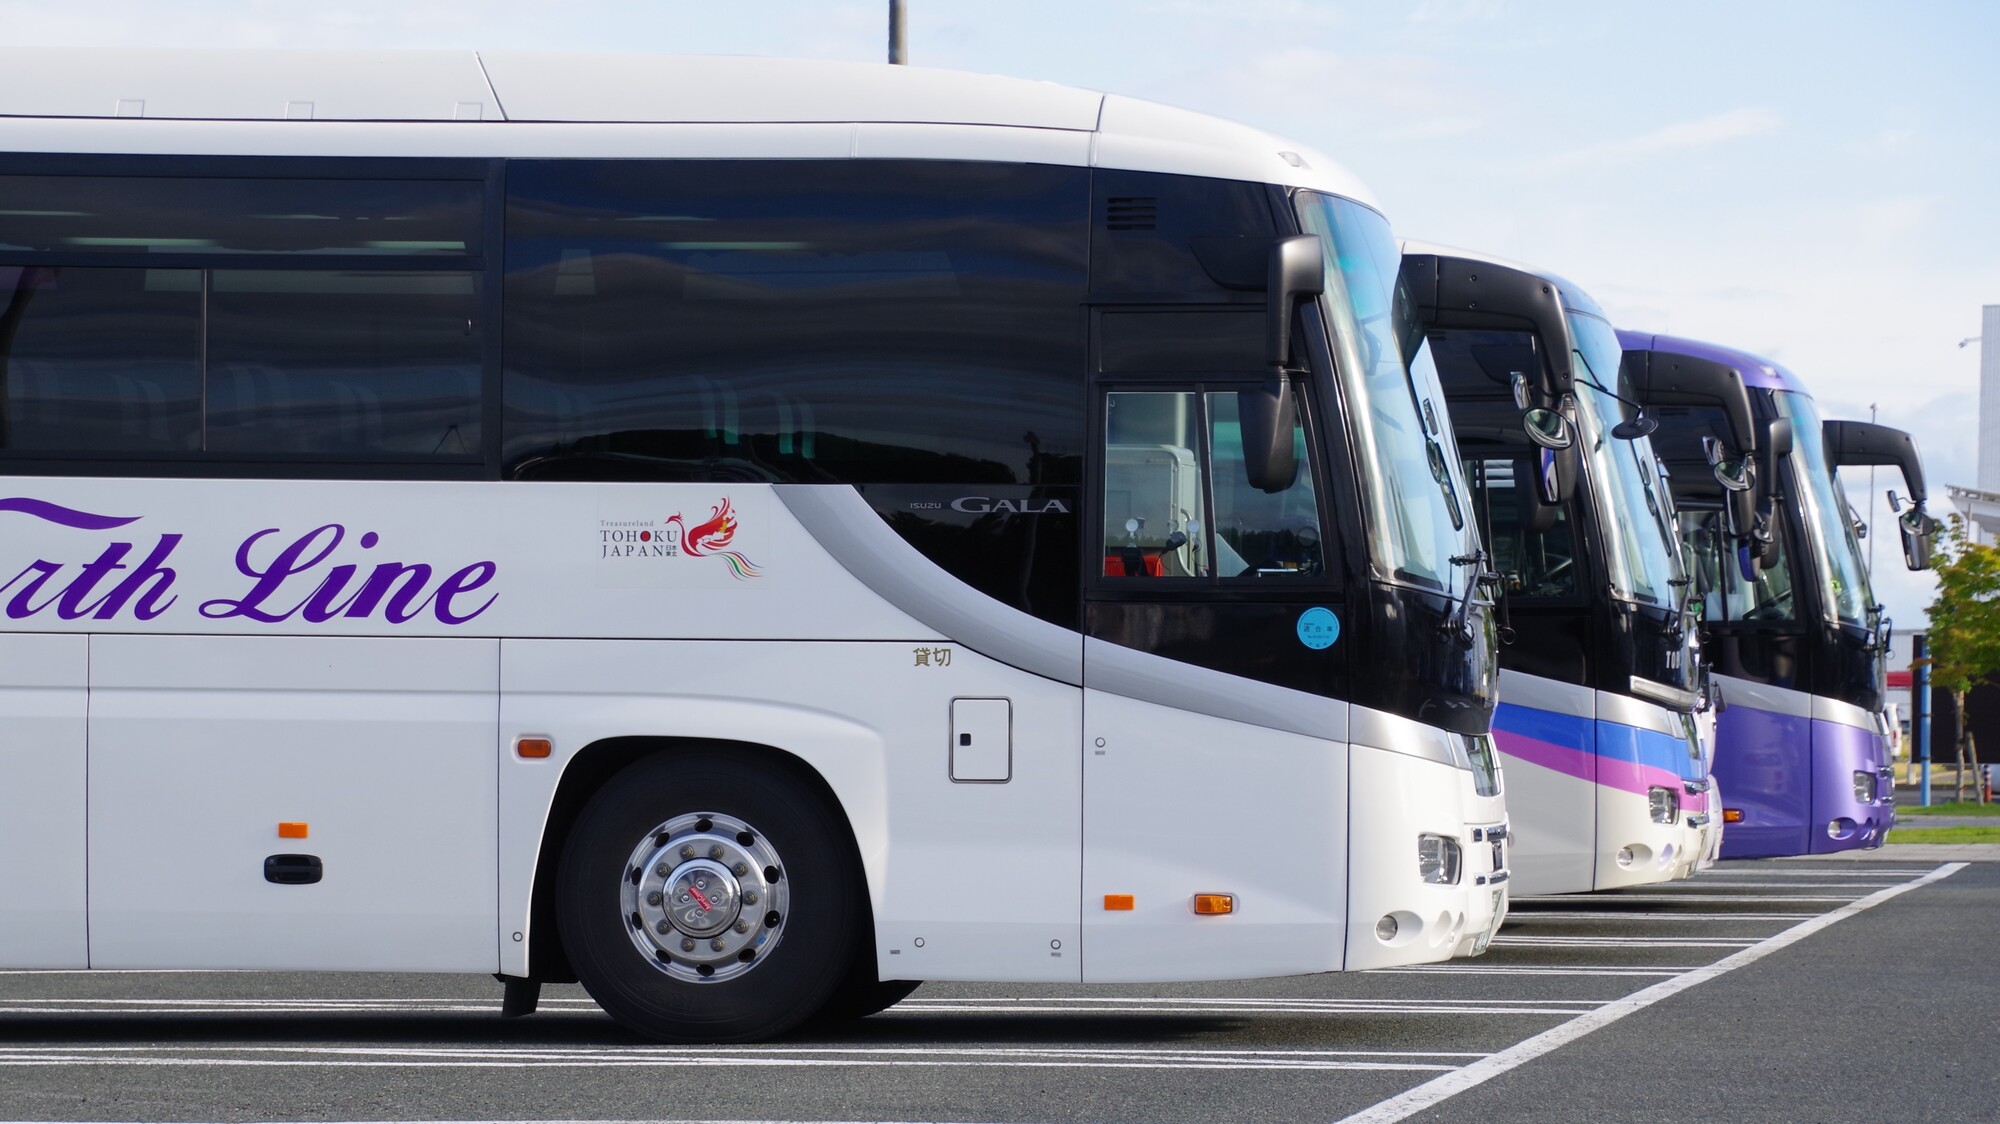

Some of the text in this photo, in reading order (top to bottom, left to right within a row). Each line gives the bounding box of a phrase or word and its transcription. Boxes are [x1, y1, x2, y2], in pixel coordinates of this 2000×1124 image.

[950, 496, 1069, 513] GALA
[600, 530, 678, 543] TOHOKU
[602, 545, 664, 559] JAPAN
[198, 523, 498, 625] Line
[913, 647, 952, 667] 貸切
